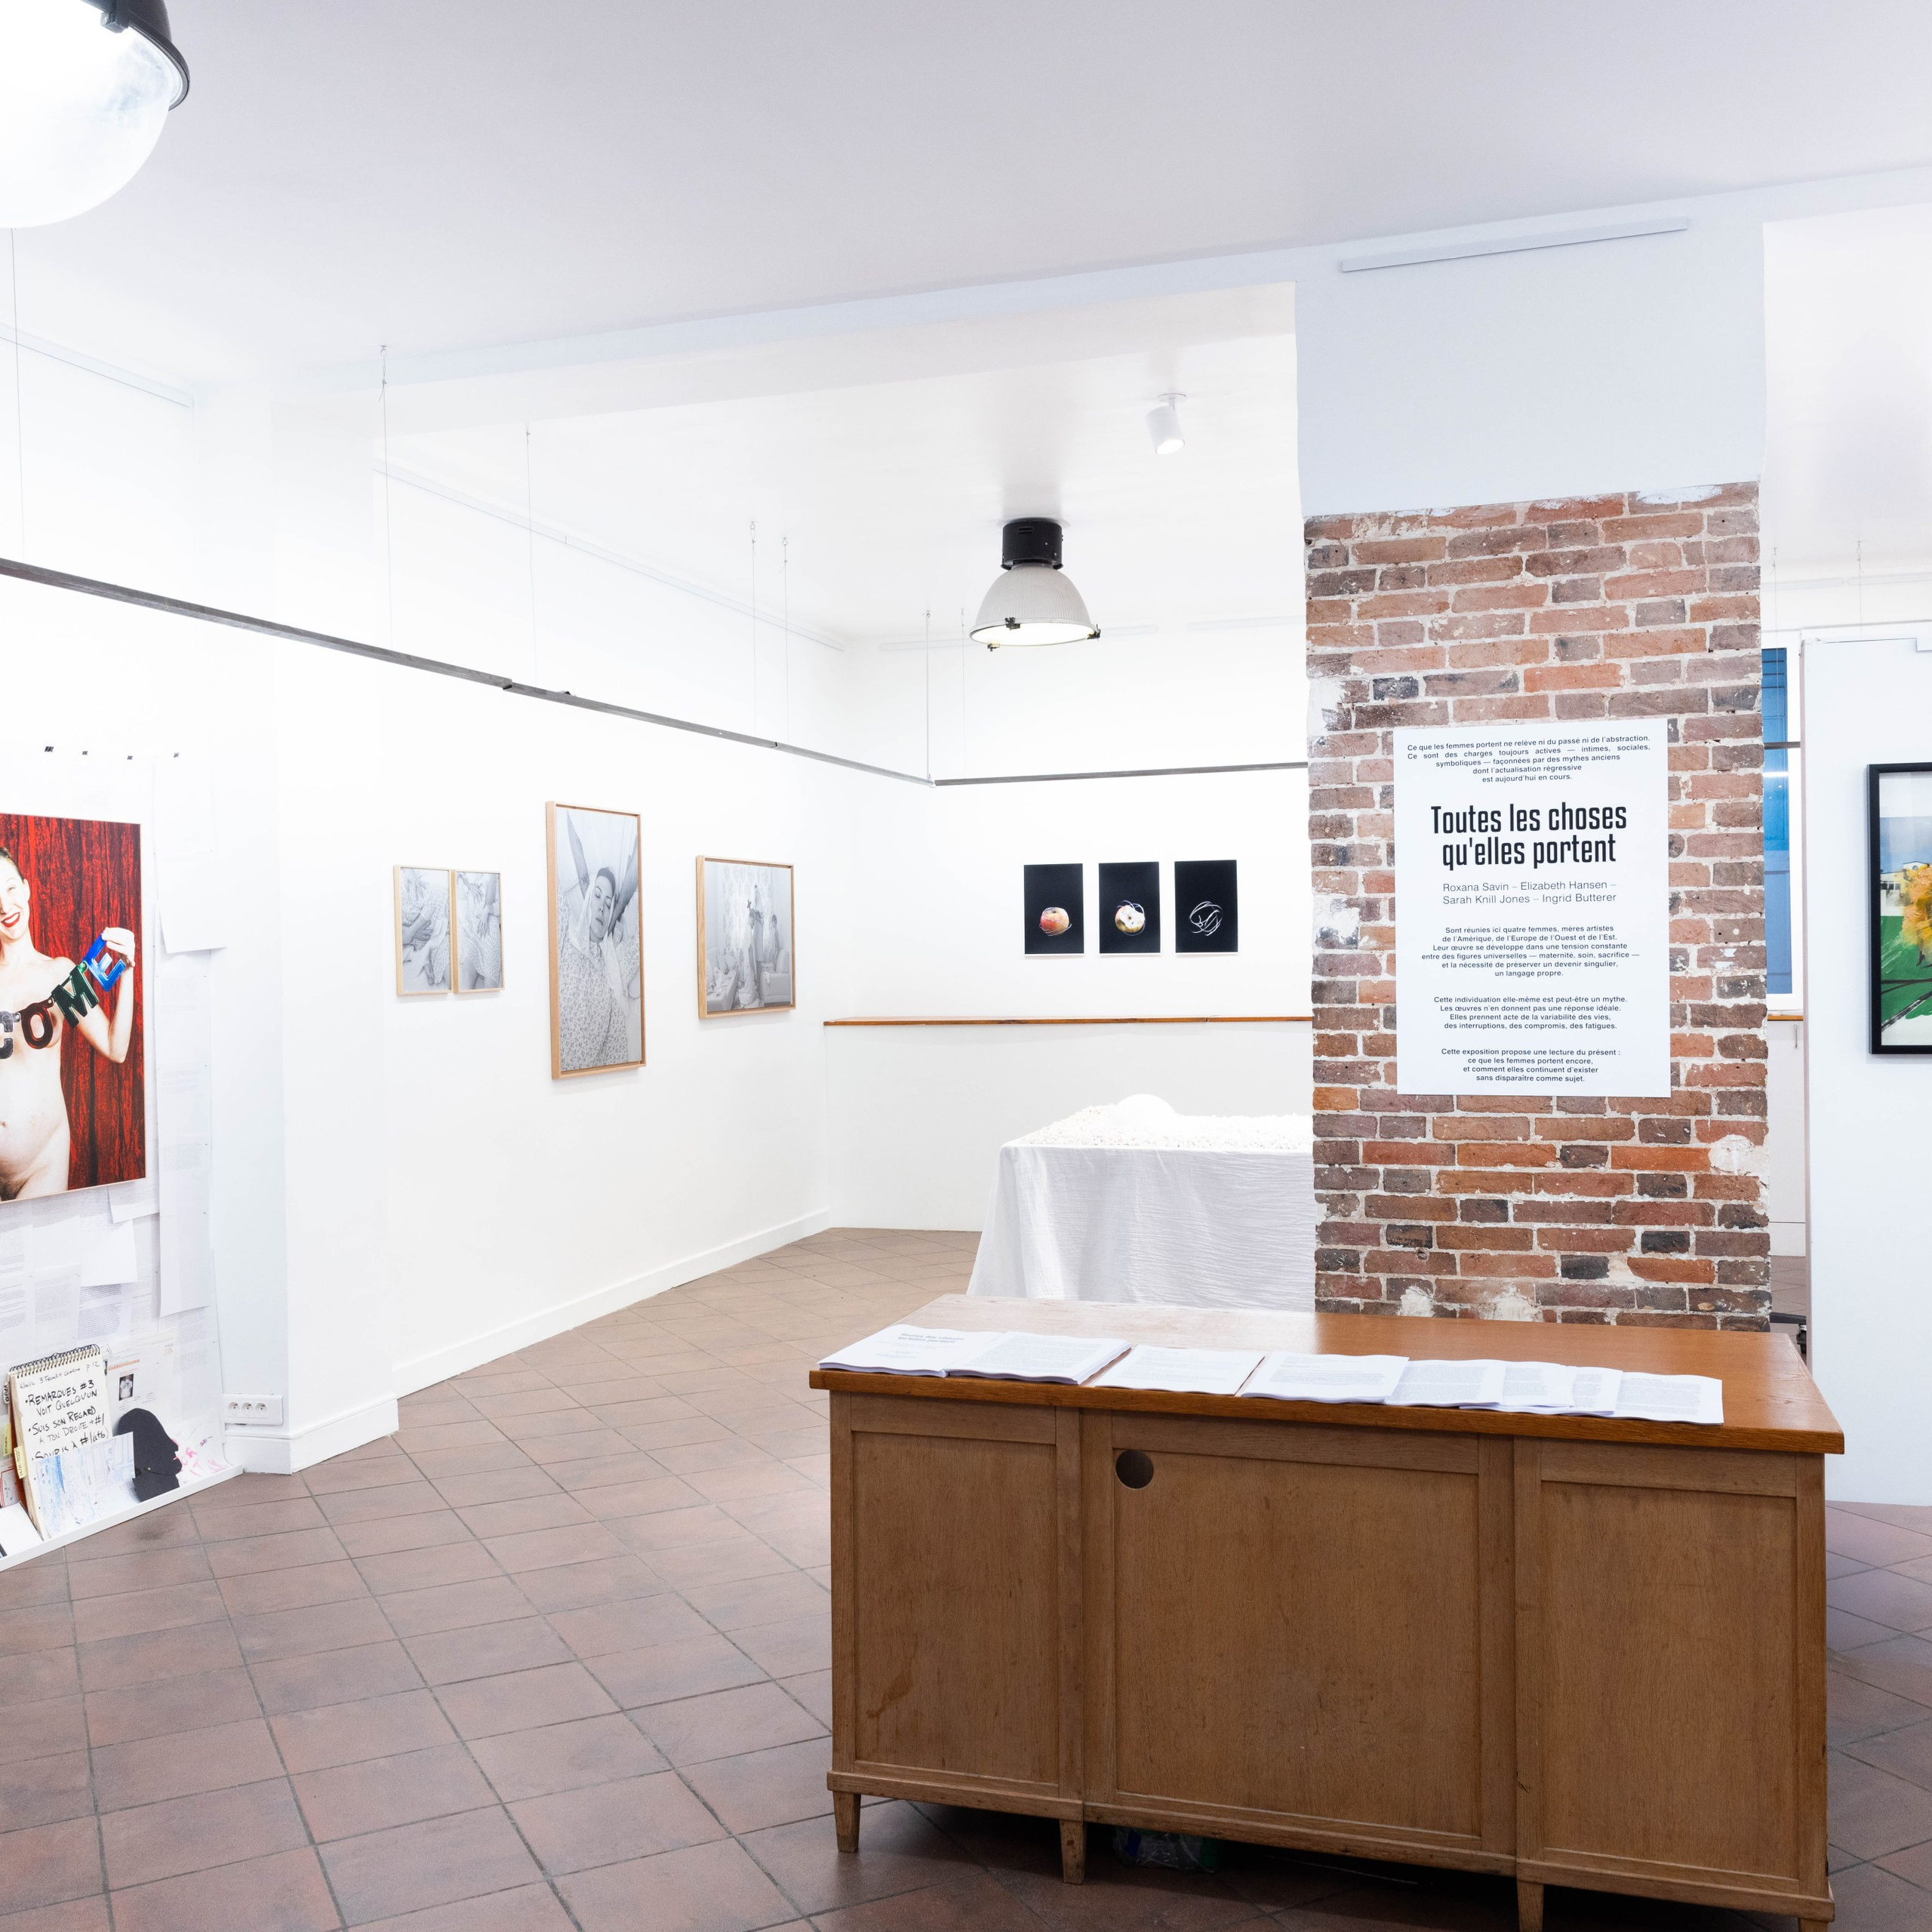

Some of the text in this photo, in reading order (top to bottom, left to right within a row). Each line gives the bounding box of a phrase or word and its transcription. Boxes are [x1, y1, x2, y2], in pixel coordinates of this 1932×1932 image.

[1475, 741, 1502, 749] portent
[1558, 738, 1580, 746] passé
[1463, 750, 1493, 758] charges
[1498, 749, 1529, 757] toujours
[1435, 759, 1481, 768] symboliques
[1493, 758, 1531, 766] façonnées
[1562, 755, 1589, 764] mythes
[1491, 765, 1541, 774] l'actualisation
[1543, 764, 1582, 773] régressive
[1495, 774, 1537, 783] aujourd'hui
[1430, 801, 1627, 835] Toutes les choses
[1442, 833, 1617, 872] qu'elles portent
[1443, 881, 1607, 892] Roxana Savin Elizabeth Hansen
[1443, 893, 1617, 905] Sarah Knill Jones Ingrid Butterer
[1506, 934, 1537, 943] l'Europe
[1485, 943, 1524, 952] développe
[1457, 953, 1482, 961] figures
[1506, 961, 1541, 969] préserver
[1583, 960, 1619, 969] singulier,
[1506, 970, 1535, 978] langage
[1555, 995, 1589, 1004] peut-être
[1602, 995, 1628, 1004] mythe.
[1564, 1004, 1595, 1013] réponse
[1585, 1023, 1617, 1031] fatigues.
[1462, 1048, 1500, 1057] exposition
[1588, 1048, 1617, 1057] présent
[1494, 1074, 1534, 1082] disparaître
[1564, 1075, 1585, 1084] sujet.
[36, 1404, 52, 1417] VOIT
